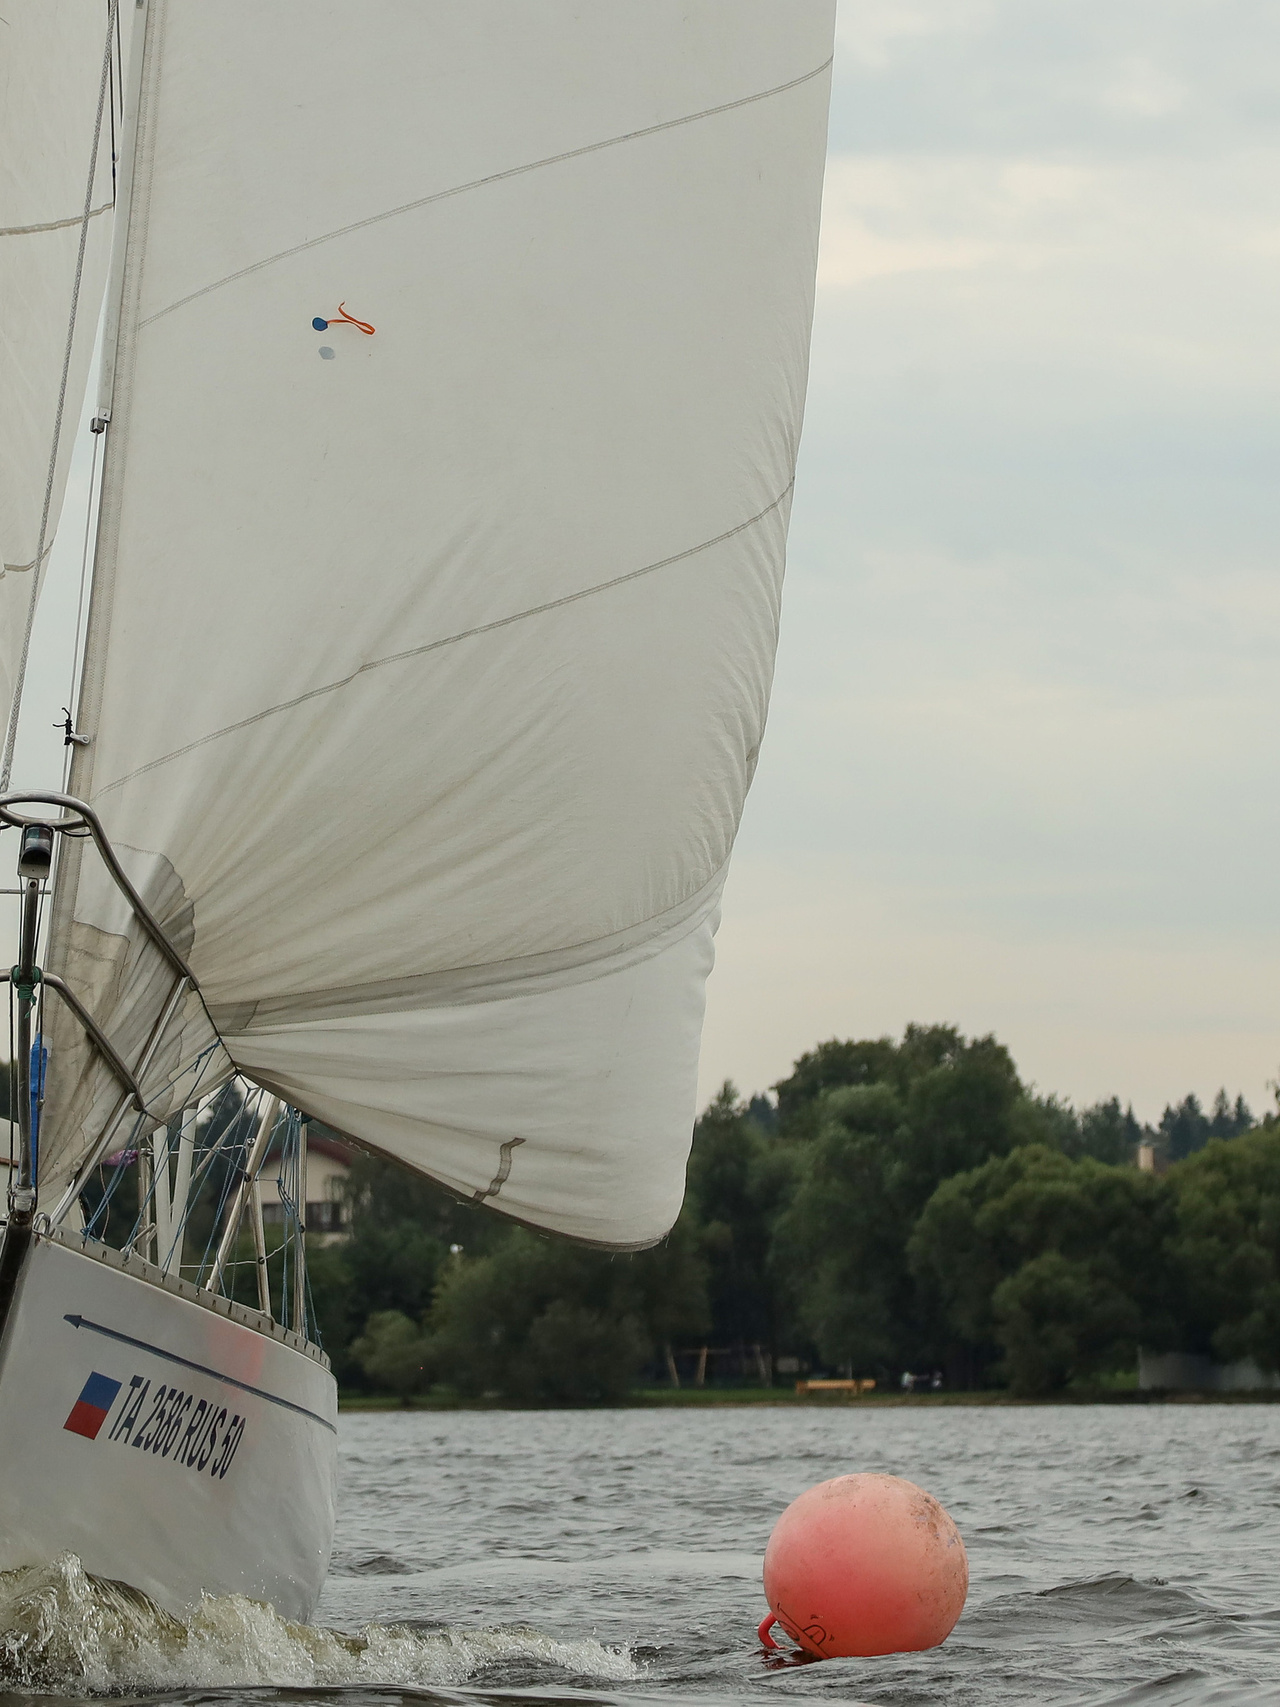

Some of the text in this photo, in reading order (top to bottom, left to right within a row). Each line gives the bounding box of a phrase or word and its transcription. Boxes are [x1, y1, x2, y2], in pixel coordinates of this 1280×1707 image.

[108, 1374, 246, 1480] TA 2586 RUS 50
